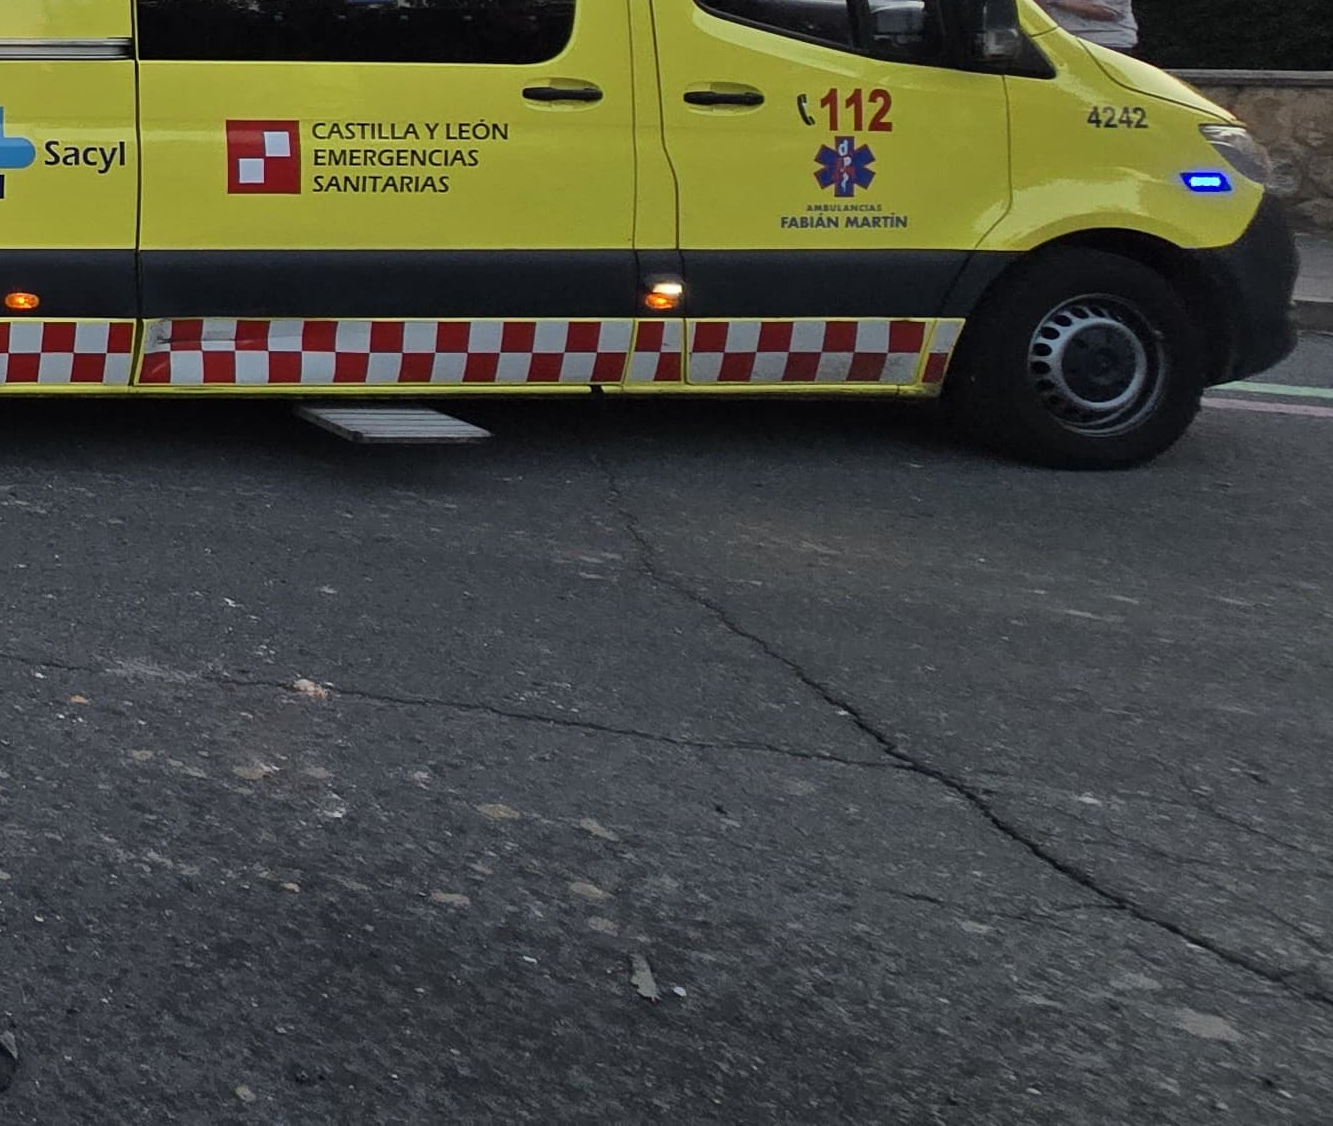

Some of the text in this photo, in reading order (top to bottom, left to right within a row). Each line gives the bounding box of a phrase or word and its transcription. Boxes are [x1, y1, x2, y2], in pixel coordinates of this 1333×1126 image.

[820, 88, 893, 132] 112
[1087, 106, 1149, 128] 4242
[312, 119, 509, 140] CASTILLA Y LEÓN
[44, 140, 125, 174] Sacyl
[313, 149, 479, 167] EMERGENCIAS
[312, 175, 450, 193] SANITARIAS
[805, 203, 883, 212] AMBULANCIAS
[780, 212, 908, 229] FABIÁN MARTÍN
